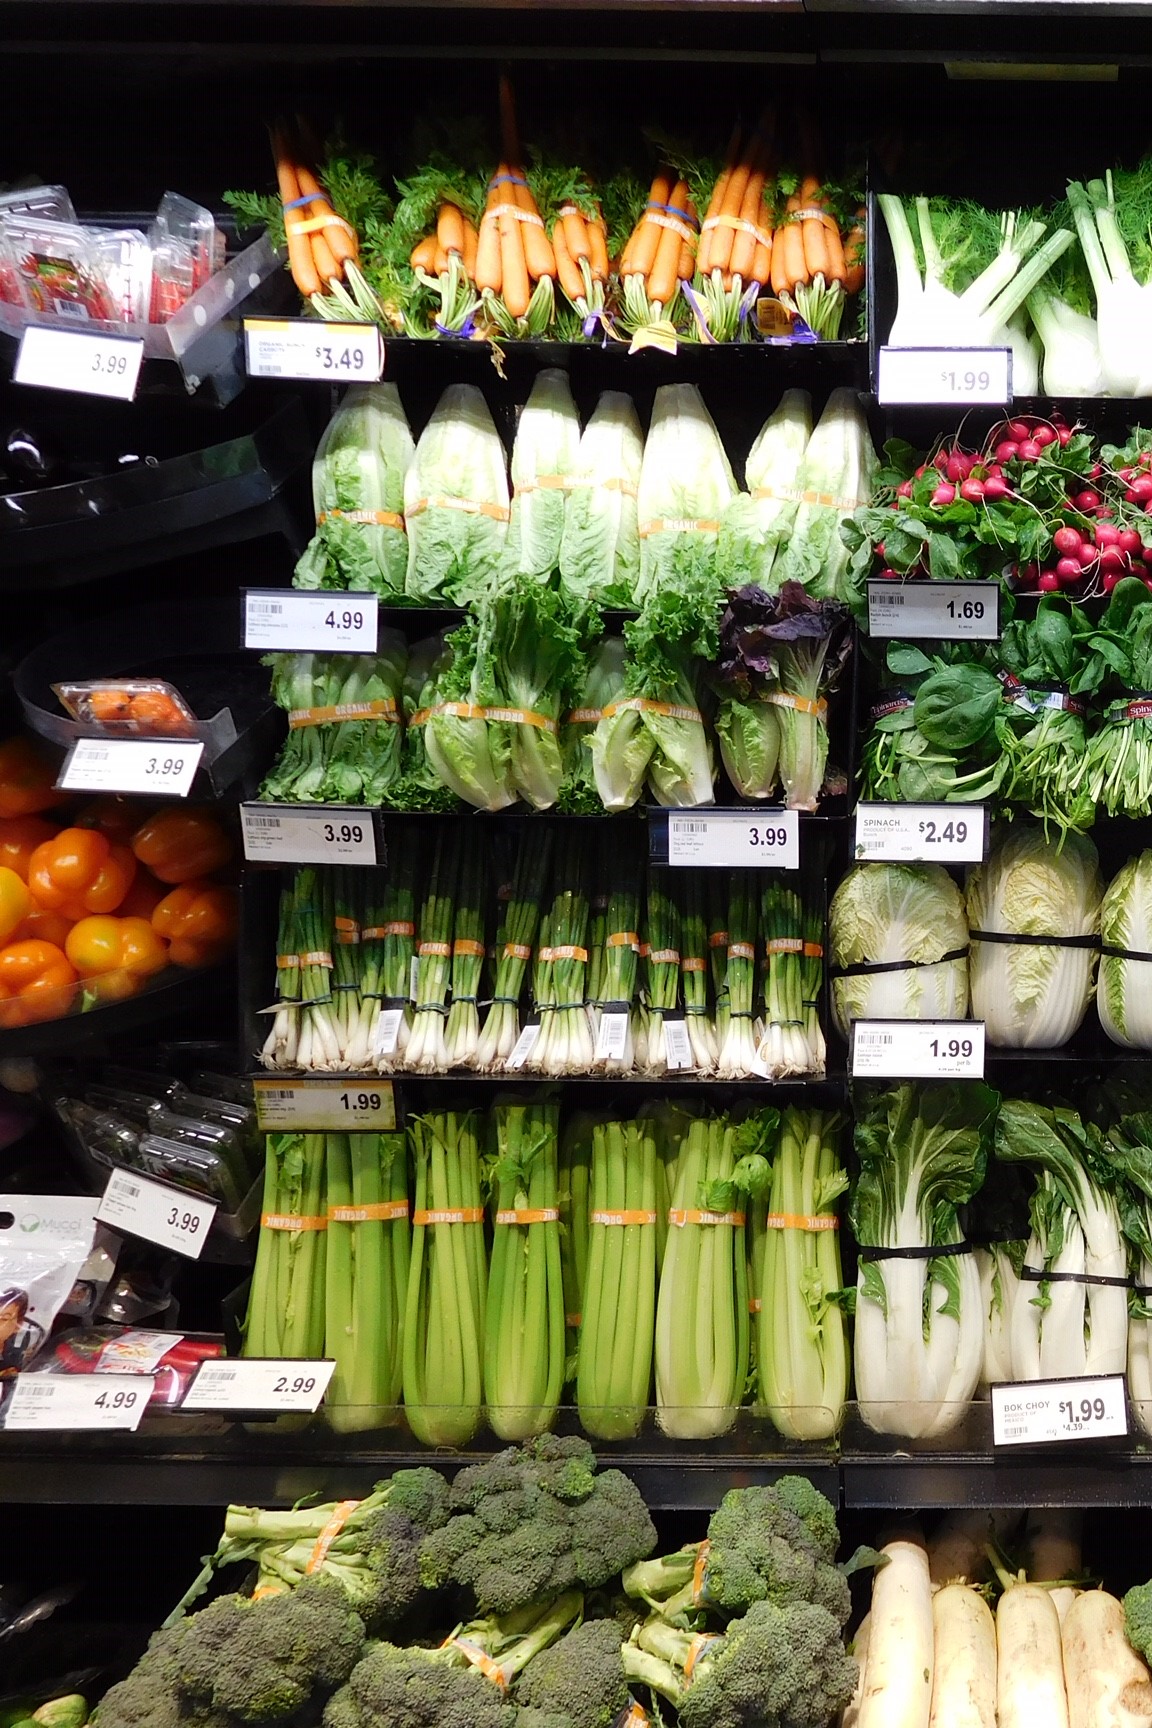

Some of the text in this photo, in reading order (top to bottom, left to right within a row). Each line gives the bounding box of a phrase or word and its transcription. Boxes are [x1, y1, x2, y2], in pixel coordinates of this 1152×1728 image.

[91, 353, 127, 375] 3.99
[315, 347, 364, 369] $3.49
[940, 371, 990, 391] $1.99
[946, 600, 985, 619] 1.69
[325, 610, 363, 630] 4.99
[335, 702, 372, 715] ORGANIC
[485, 708, 525, 723] ORGANIC
[574, 709, 601, 720] ORGAN
[145, 758, 184, 775] 3.99
[863, 819, 901, 827] SPINACH
[918, 821, 968, 843] $2.49
[324, 824, 363, 843] 3.99
[749, 827, 787, 846] 3.99
[929, 1039, 973, 1058] 1.99
[340, 1093, 381, 1110] 1.99
[167, 1207, 200, 1234] 3.99
[266, 1216, 304, 1229] ORGANIC
[334, 1209, 369, 1221] ORGANIC
[427, 1211, 464, 1223] ORGANIC
[272, 1376, 316, 1393] 2.99
[94, 1391, 138, 1409] 4.99
[1003, 1401, 1050, 1412] BOK CHOY
[1059, 1397, 1106, 1423] $1.99
